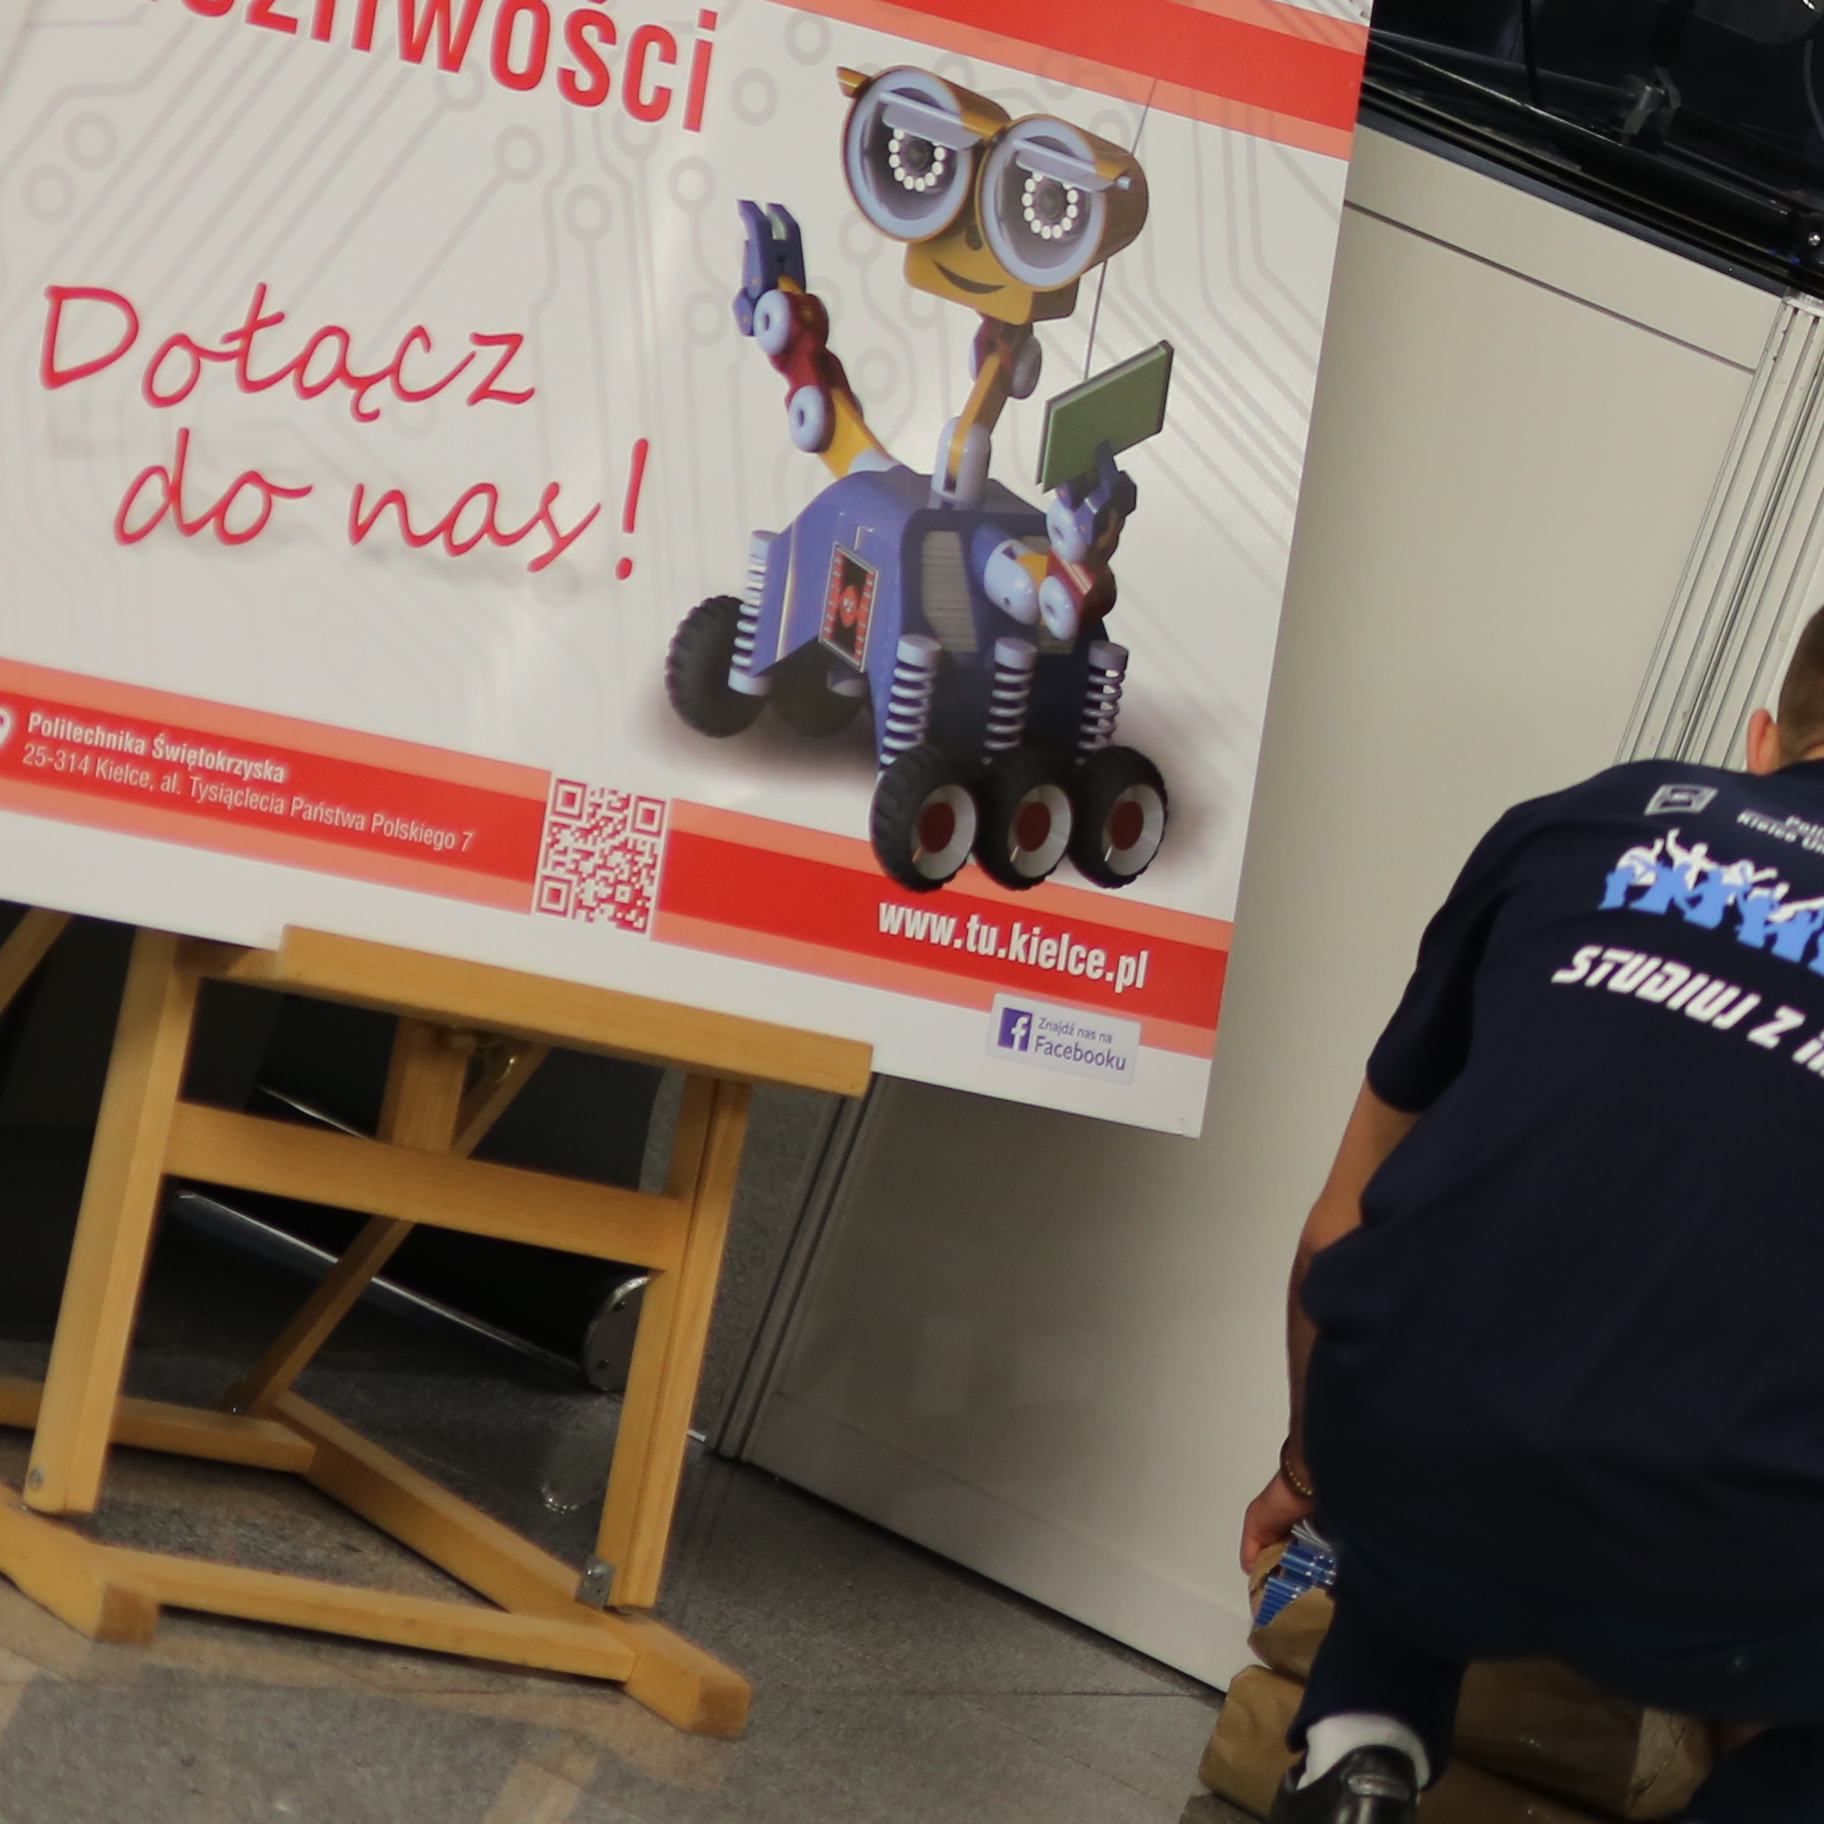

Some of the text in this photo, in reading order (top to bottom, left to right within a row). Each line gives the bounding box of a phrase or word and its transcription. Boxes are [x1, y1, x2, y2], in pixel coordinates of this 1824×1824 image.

[39, 283, 535, 422] Dołącz
[114, 427, 650, 581] do nas!
[27, 712, 287, 785] Politechnika Świętokrzyska
[22, 743, 475, 853] 25-314 Kielce, al. Tysiąclecia Państwa Polskiego 7
[878, 900, 1151, 993] www.tu.kielce.pl
[1034, 1035, 1127, 1072] Facebooku
[1038, 1017, 1113, 1044] Znajdź nas na
[1747, 1005, 1807, 1050] Z
